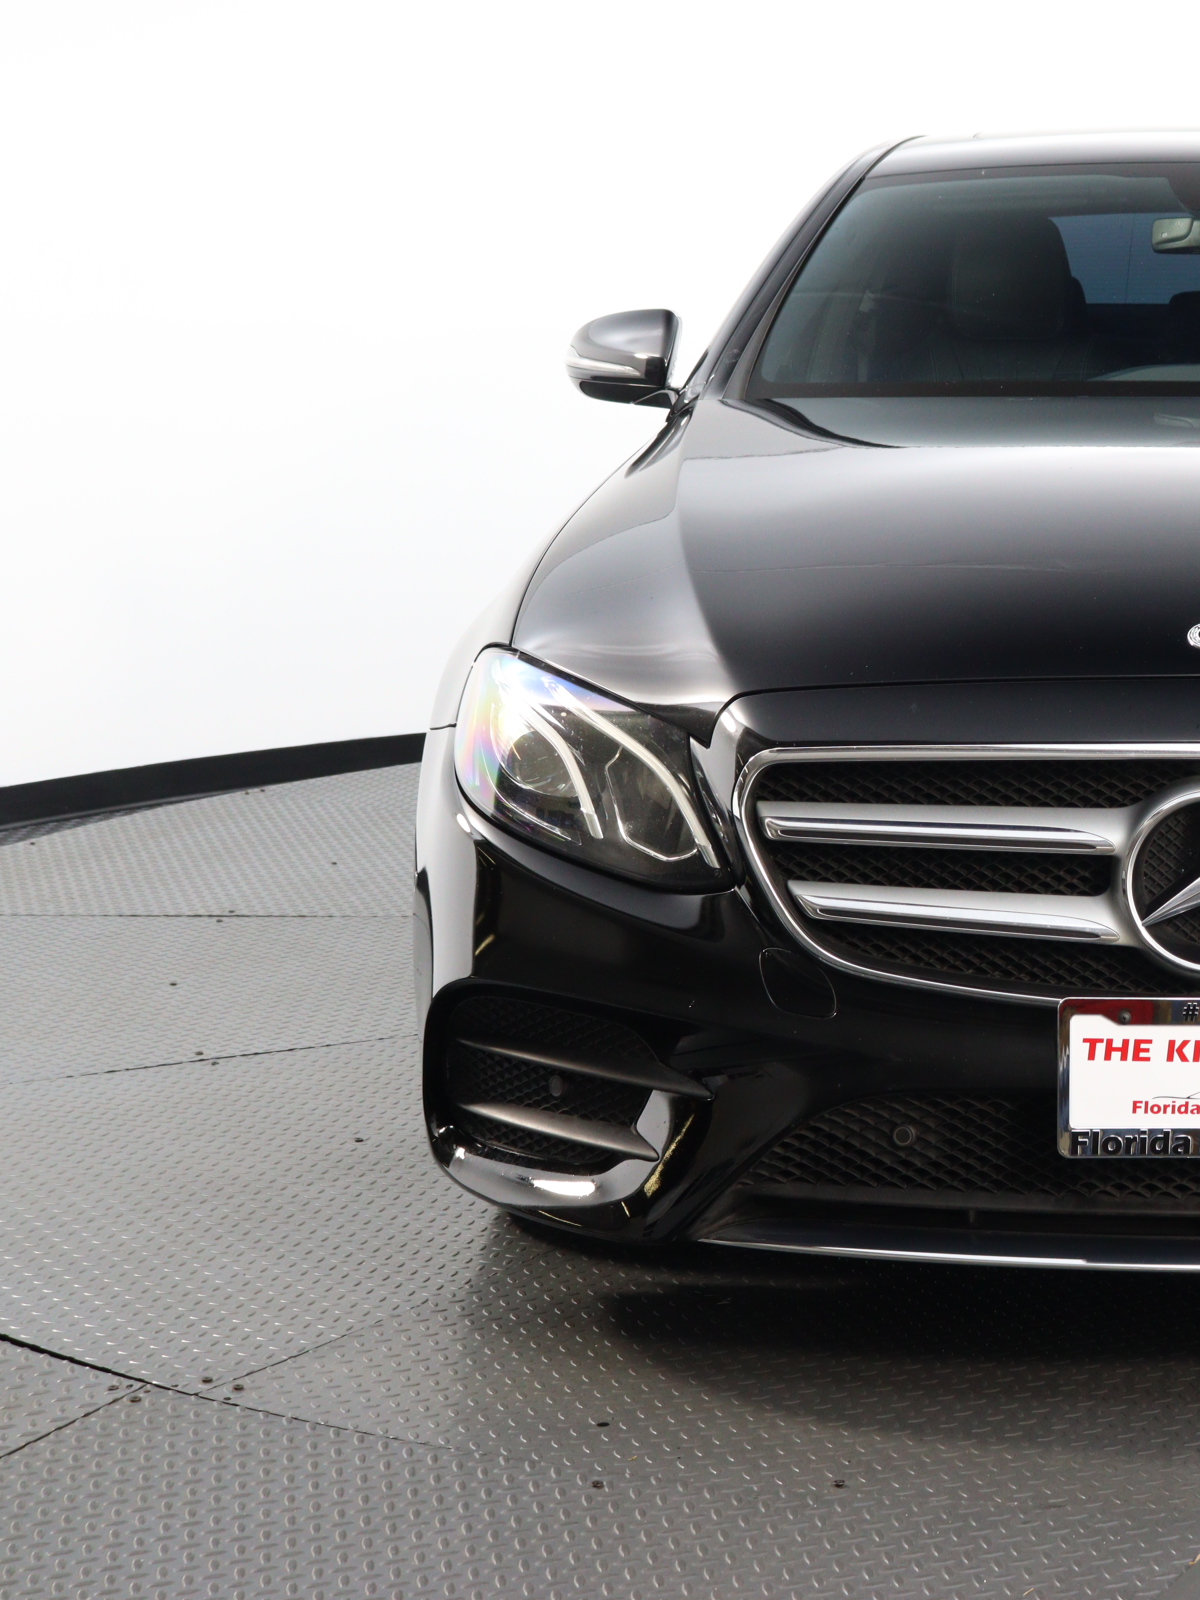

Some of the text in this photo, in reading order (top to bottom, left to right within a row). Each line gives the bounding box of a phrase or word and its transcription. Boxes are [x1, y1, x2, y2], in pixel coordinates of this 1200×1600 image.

[1082, 1038, 1153, 1062] THE
[1132, 1101, 1200, 1115] Florida
[1070, 1129, 1193, 1155] Florida
